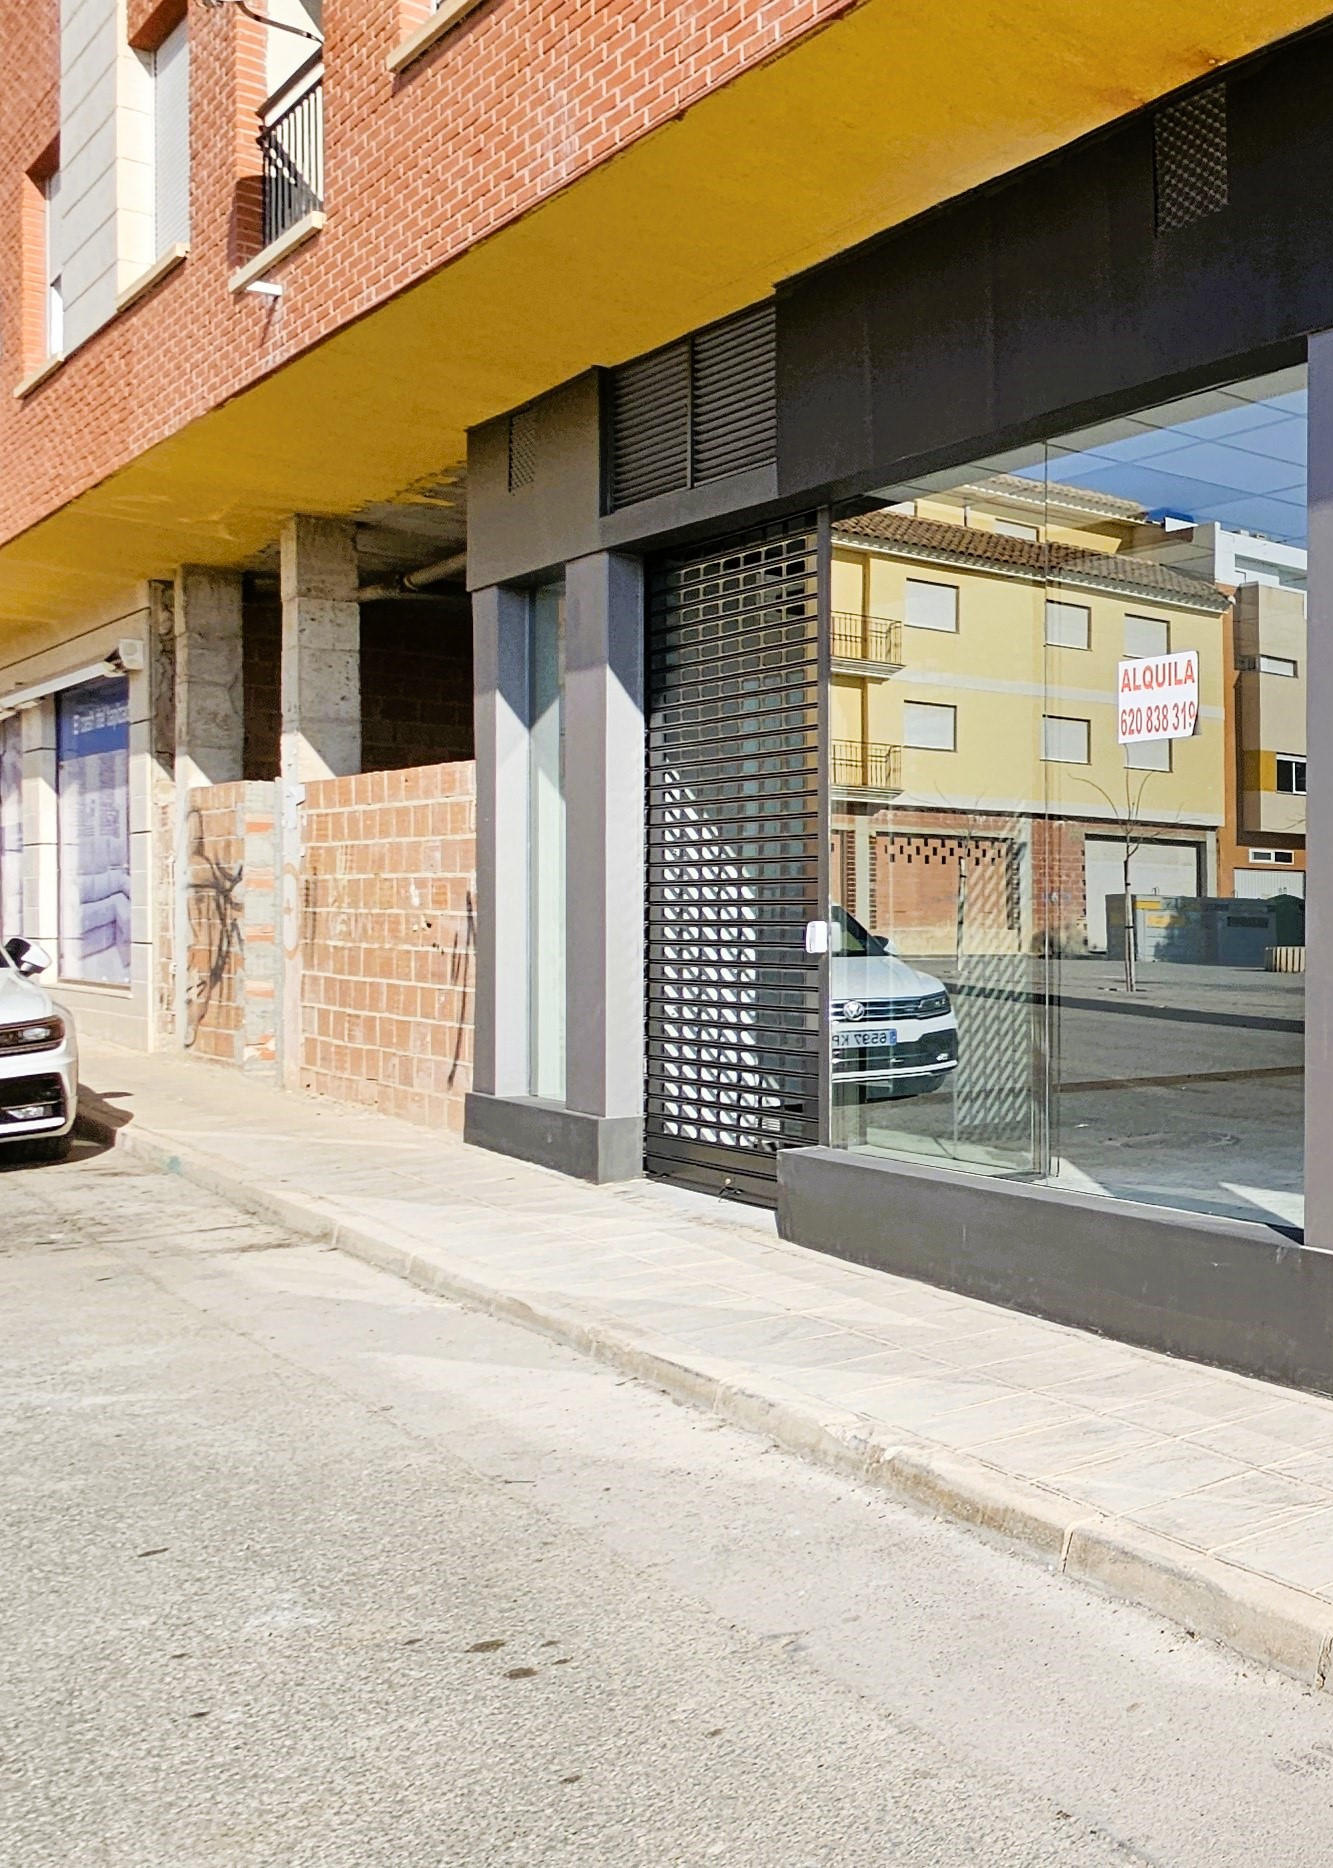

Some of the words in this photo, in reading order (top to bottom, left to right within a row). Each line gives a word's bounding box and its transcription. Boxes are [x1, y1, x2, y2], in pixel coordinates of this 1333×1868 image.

[1121, 659, 1195, 692] ALQUILA
[1120, 706, 1142, 736] 620
[1146, 704, 1169, 733] 838
